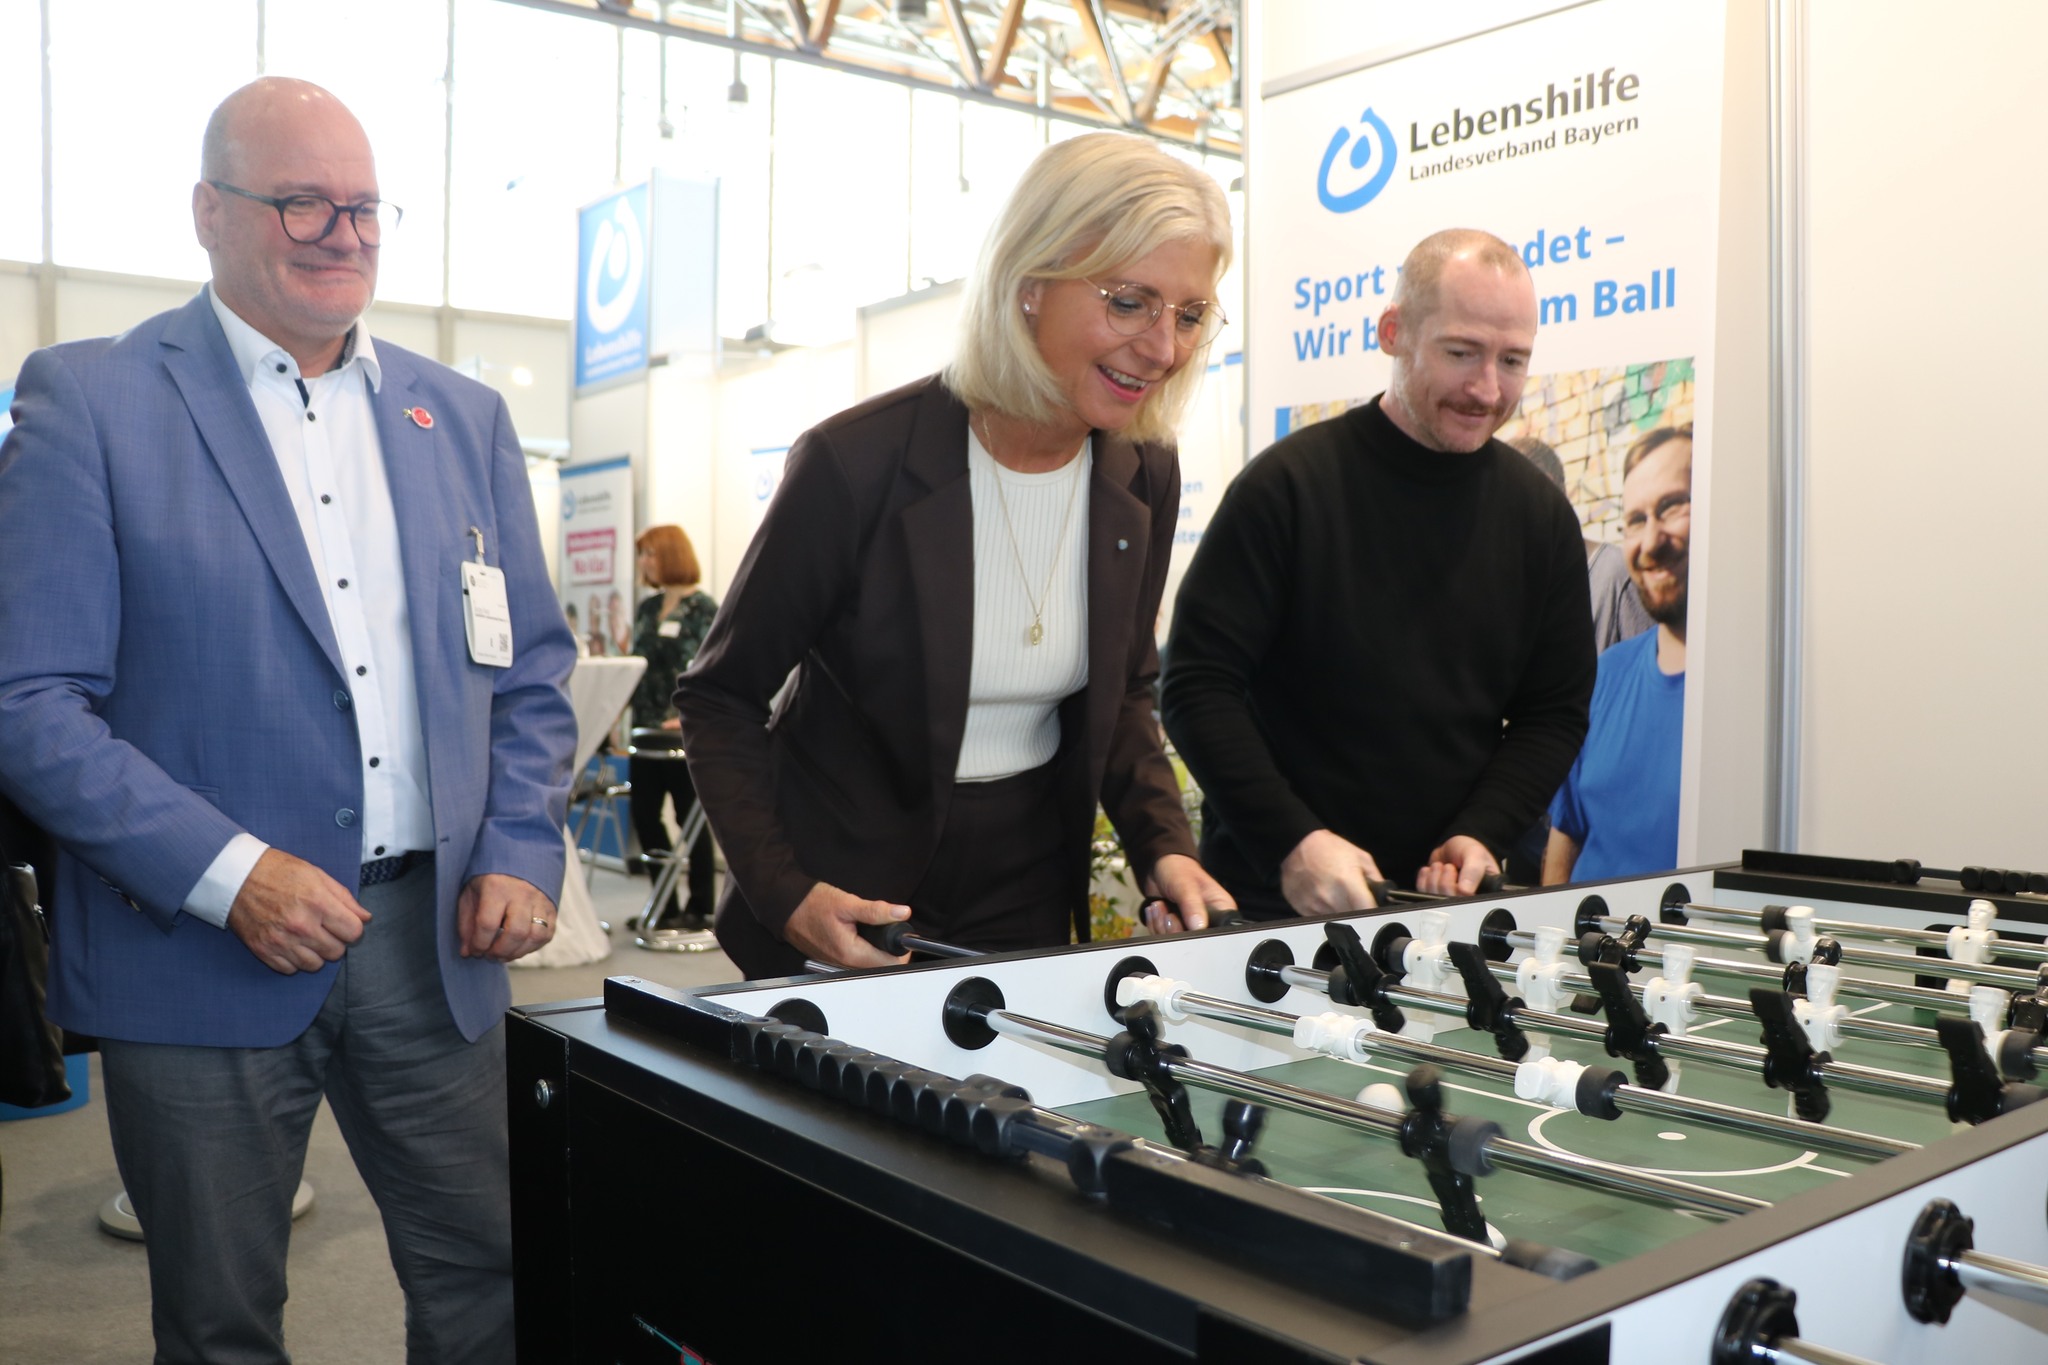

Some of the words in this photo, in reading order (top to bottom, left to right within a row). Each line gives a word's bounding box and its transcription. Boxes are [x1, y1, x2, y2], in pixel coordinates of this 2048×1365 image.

[1410, 67, 1640, 153] Lebenshilfe
[1409, 130, 1557, 181] Landesverband
[1564, 116, 1640, 150] Bayern
[1293, 322, 1352, 362] Wir
[1362, 316, 1380, 352] b
[1593, 267, 1676, 318] Ball
[1294, 265, 1385, 317] Sport
